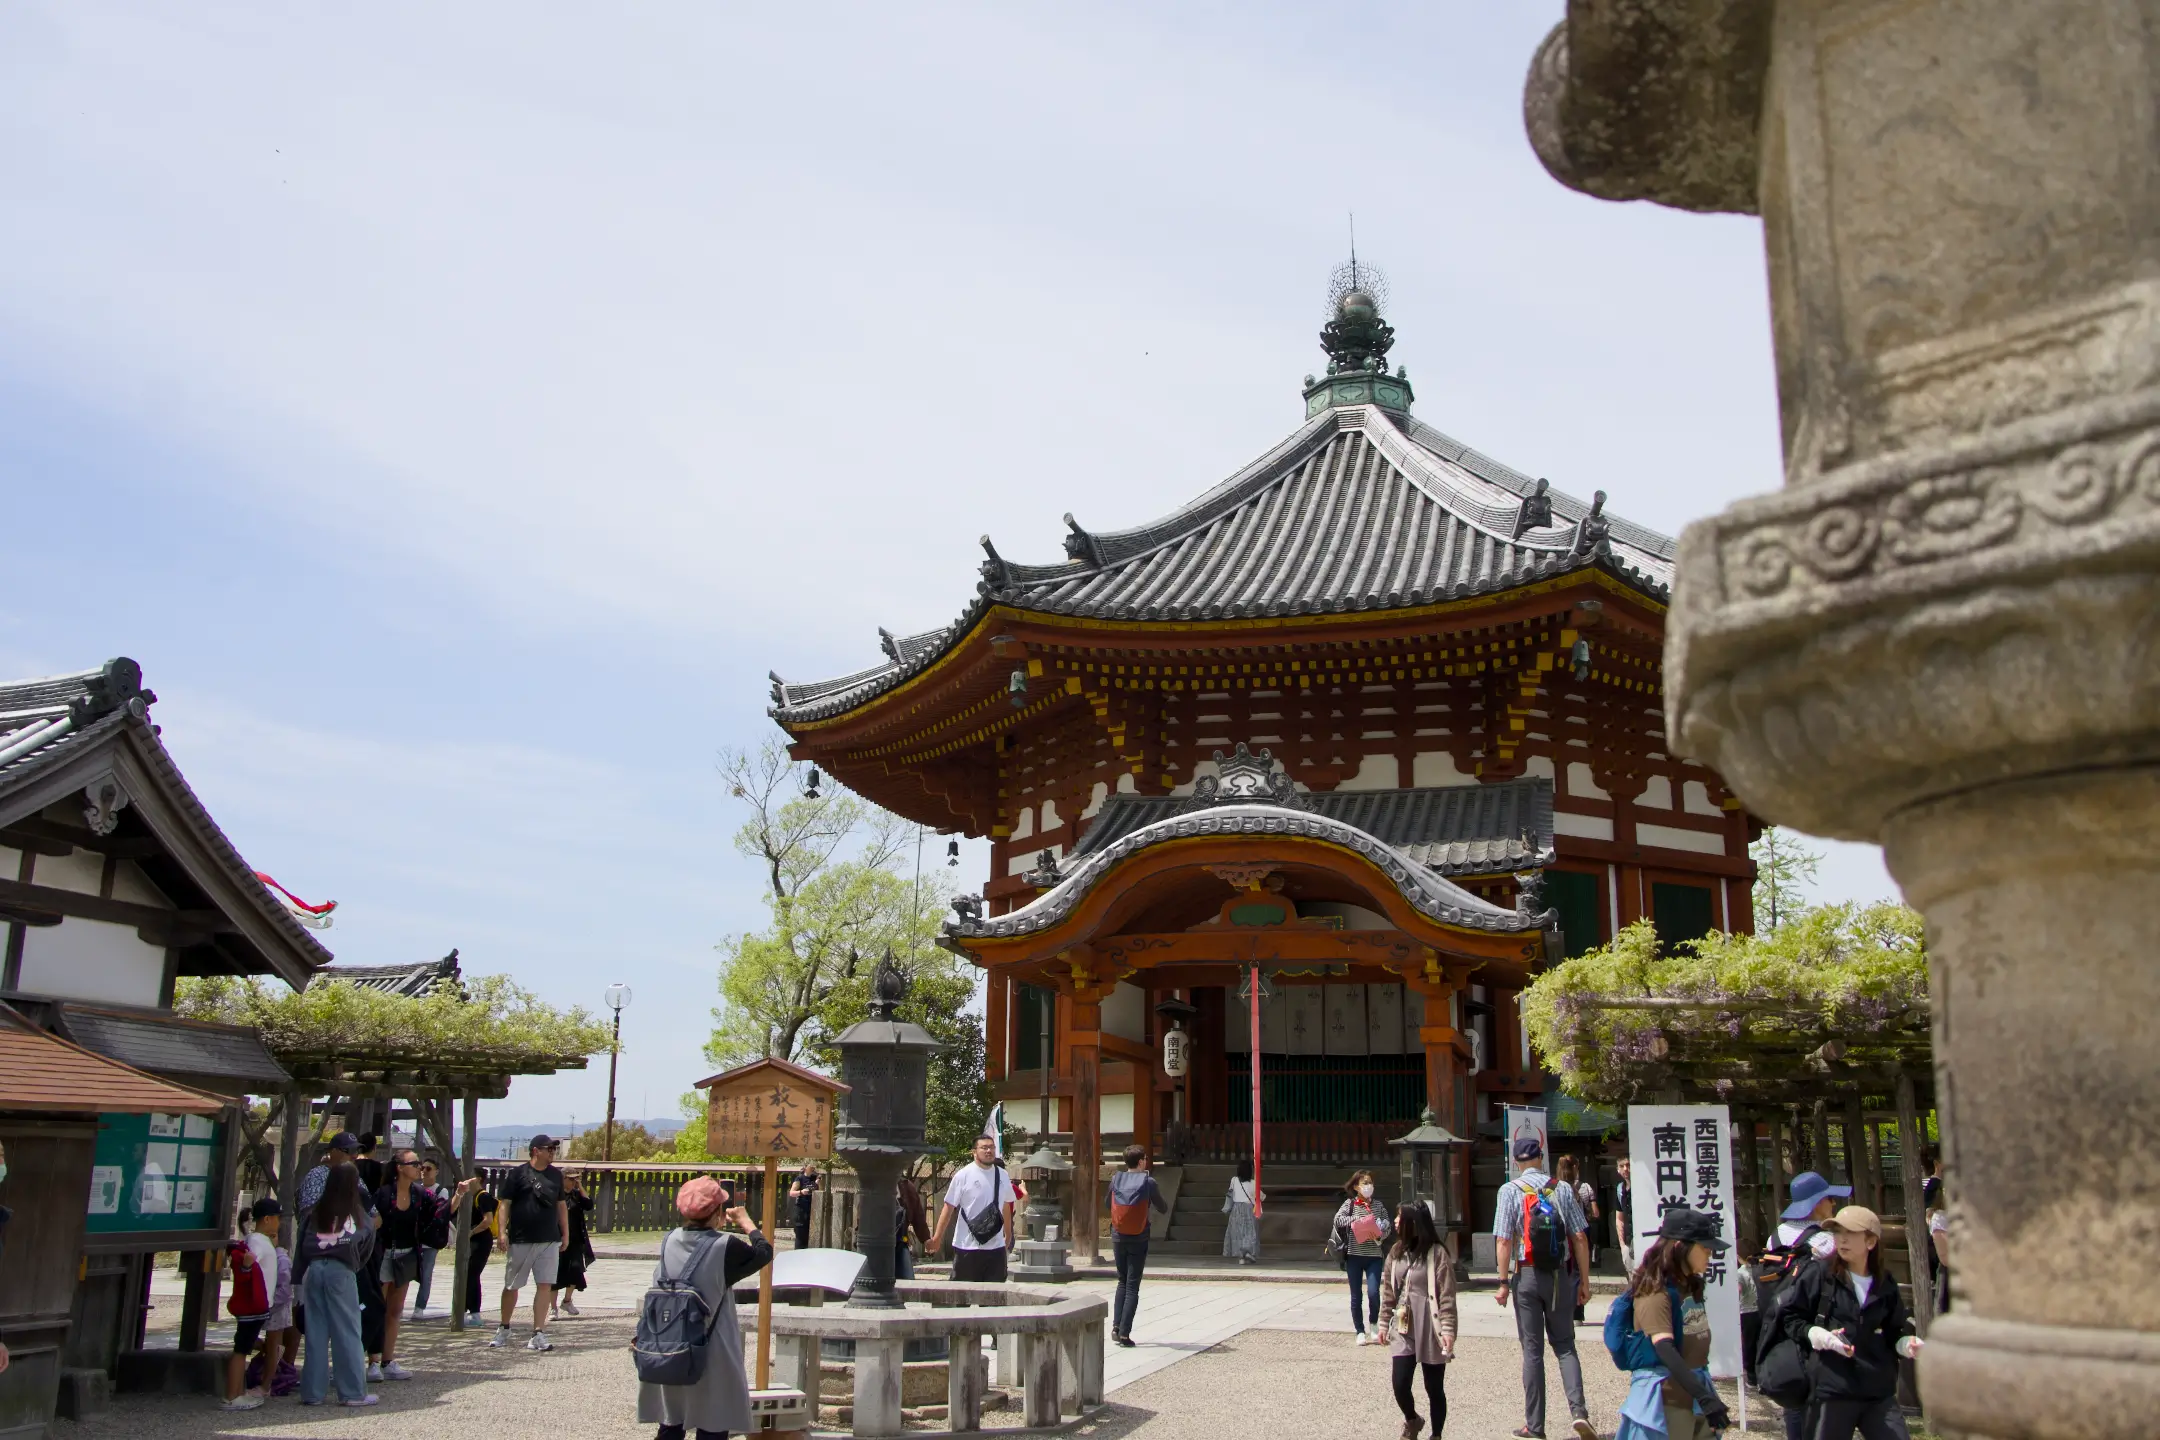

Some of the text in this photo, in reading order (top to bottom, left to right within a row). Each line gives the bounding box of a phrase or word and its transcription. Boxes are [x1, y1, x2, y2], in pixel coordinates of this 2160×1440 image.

[1167, 1036, 1180, 1070] 南円堂
[769, 1086, 798, 1152] 放生会
[1694, 1118, 1727, 1287] 西国第九番所
